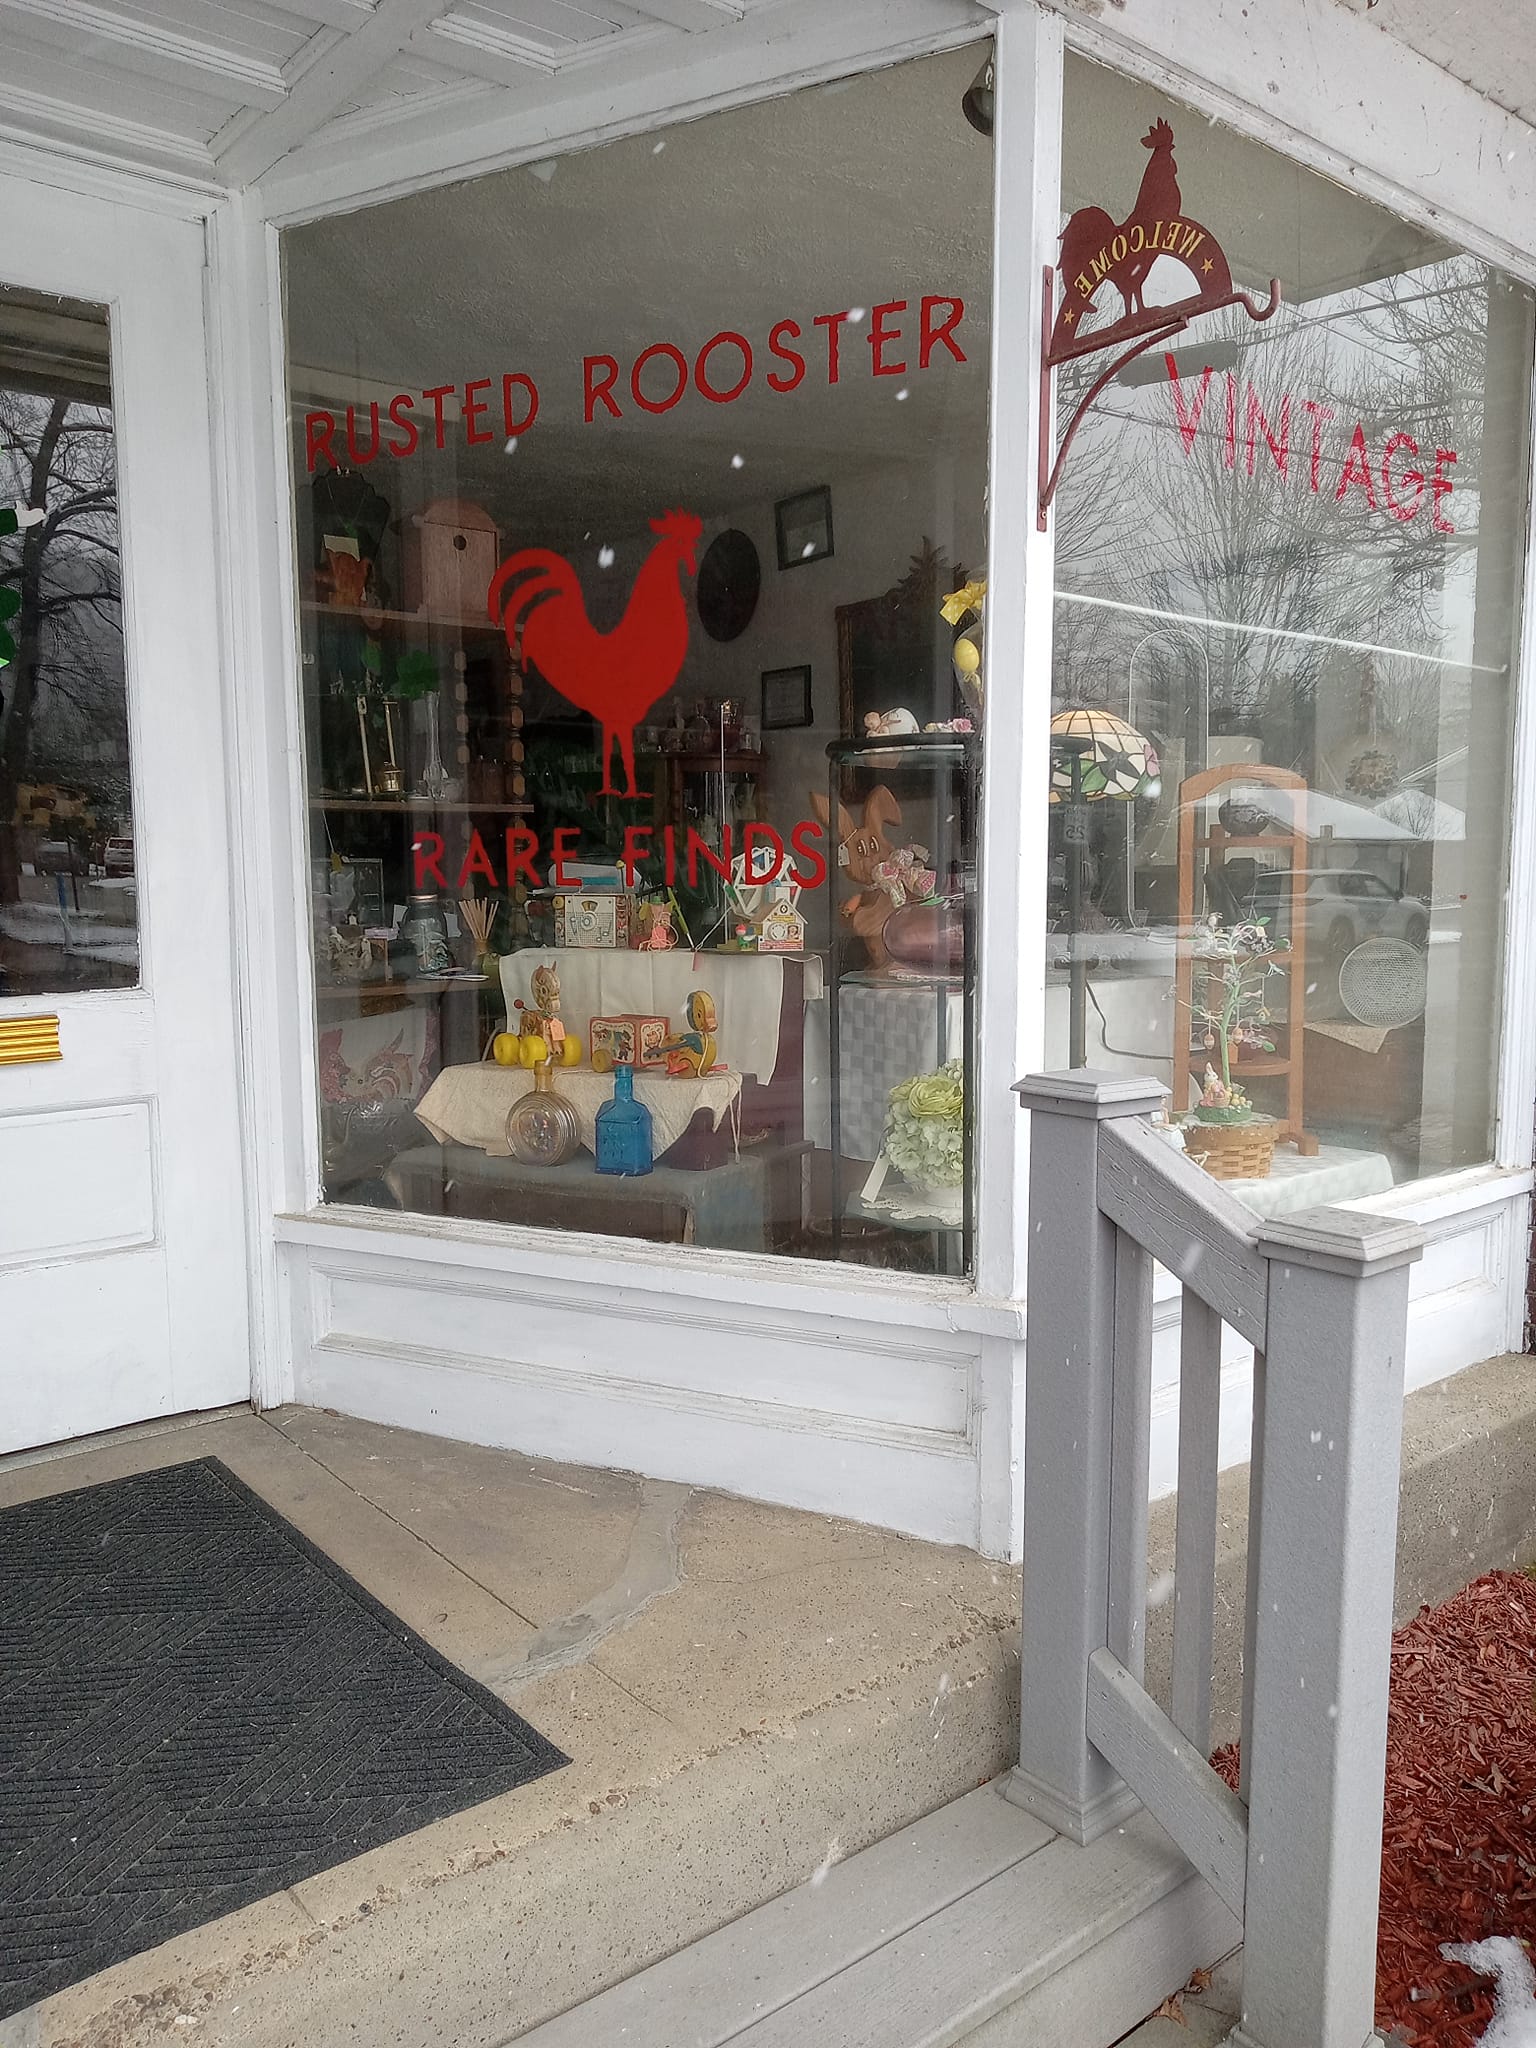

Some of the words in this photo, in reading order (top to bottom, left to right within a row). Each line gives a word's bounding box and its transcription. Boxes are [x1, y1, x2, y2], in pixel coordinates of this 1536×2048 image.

[305, 373, 539, 473] RUSTED
[583, 296, 967, 422] ROOSTER
[1164, 352, 1457, 534] VINTAGE
[412, 826, 582, 889] RARE
[622, 821, 827, 889] FINDS
